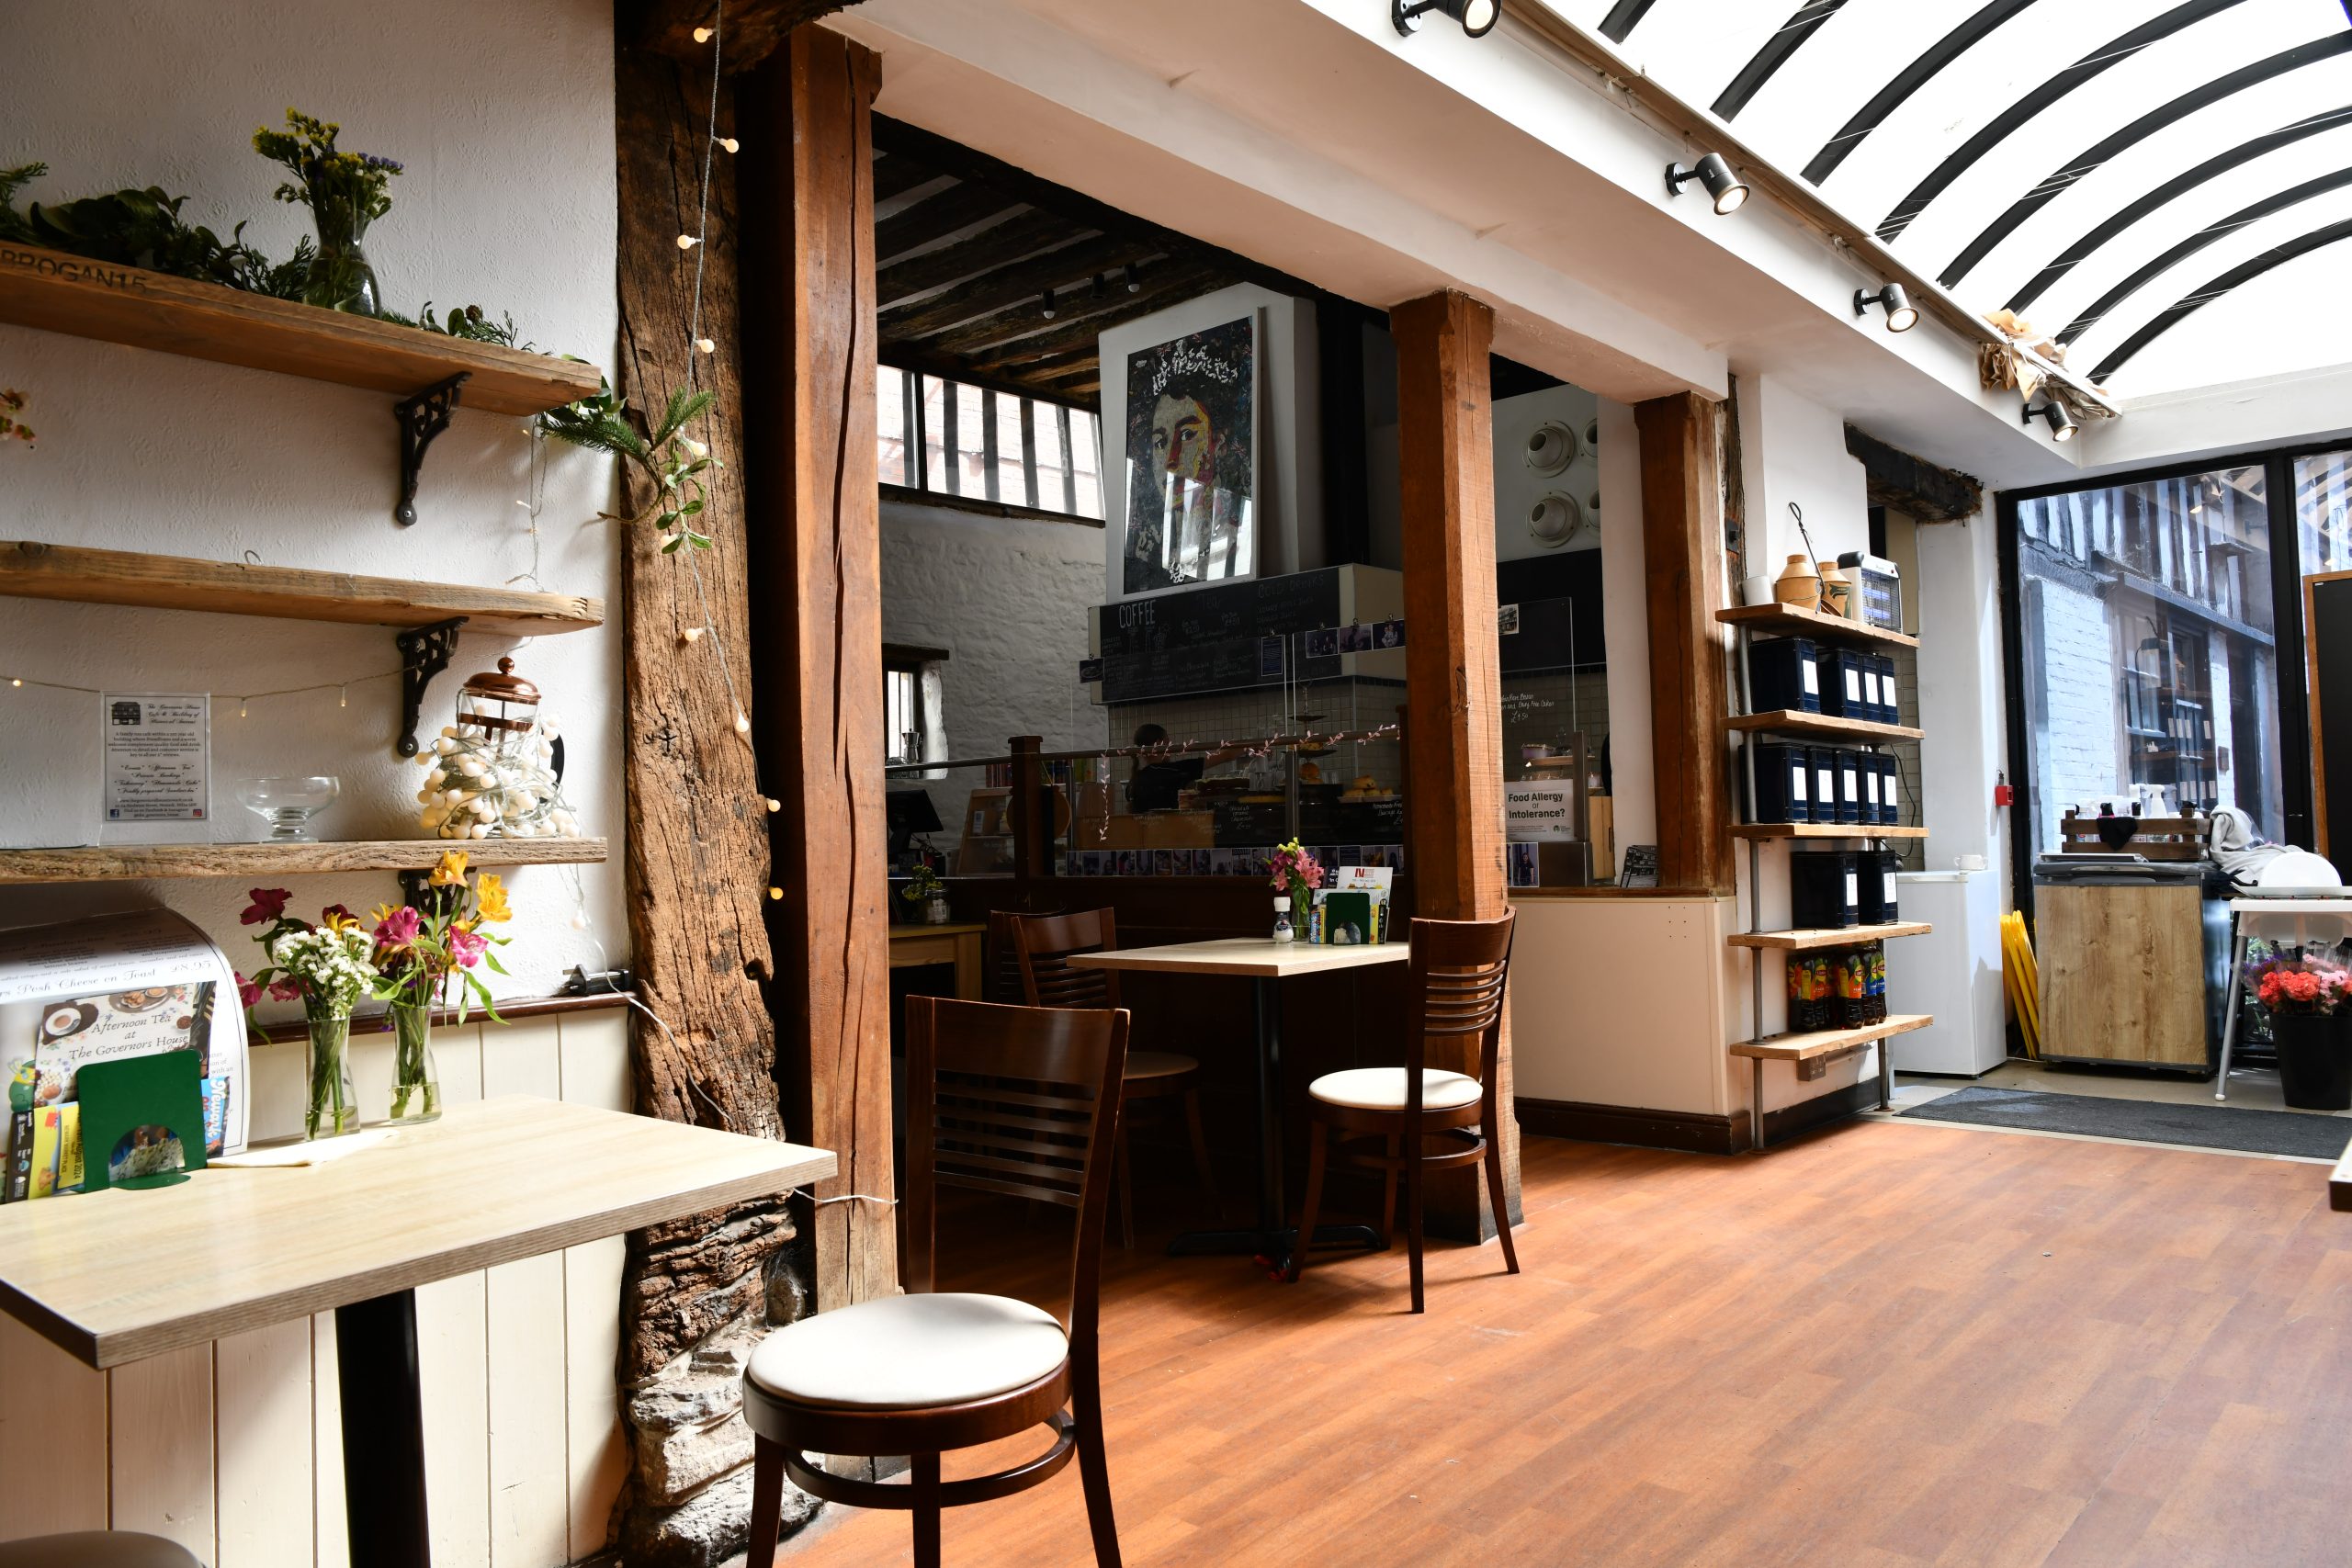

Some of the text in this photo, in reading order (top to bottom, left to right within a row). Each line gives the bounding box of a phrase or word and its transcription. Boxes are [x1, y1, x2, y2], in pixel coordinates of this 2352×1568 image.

[1119, 599, 1157, 628] COFFEE
[1508, 792, 1563, 803] Food Allergy
[1508, 808, 1566, 819] Intolerance?
[17, 984, 51, 993] Posh
[59, 977, 98, 989] Cheese
[123, 967, 155, 982] Toast
[170, 959, 211, 972] £8.95
[91, 1014, 172, 1034] Afternoon Tea
[124, 1031, 136, 1040] at
[69, 1034, 188, 1060] The Governors House
[208, 1078, 227, 1138] Newark
[74, 1164, 83, 1180] 2024
